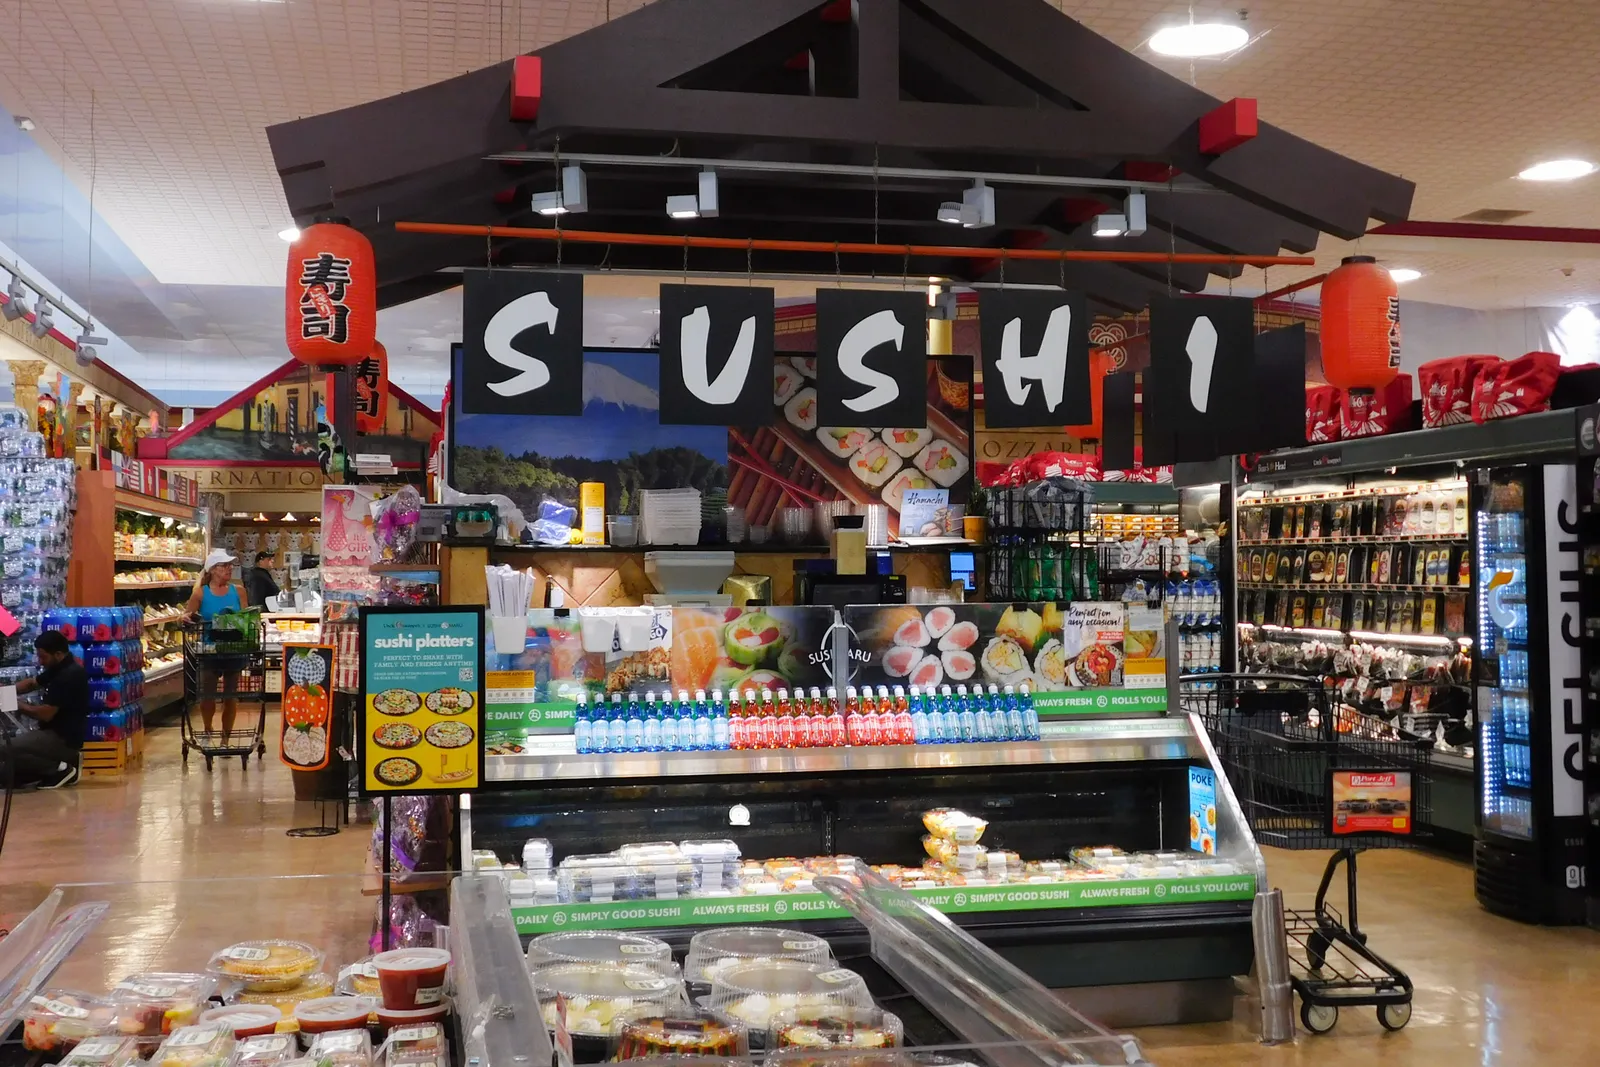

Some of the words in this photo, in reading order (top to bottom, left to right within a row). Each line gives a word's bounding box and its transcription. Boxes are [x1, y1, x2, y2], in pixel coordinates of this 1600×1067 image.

[484, 291, 1218, 414] SUSHI
[908, 492, 944, 505] Hamachi
[348, 542, 369, 553] GIR
[1068, 606, 1097, 619] Perfect
[1097, 607, 1111, 618] for
[1067, 620, 1084, 629] any
[1085, 617, 1121, 626] occasion!
[374, 633, 413, 648] sushi
[415, 633, 474, 652] platters
[1065, 697, 1093, 706] FRESH
[1112, 696, 1139, 705] ROLLS
[1140, 695, 1160, 704] YOU
[495, 711, 524, 720] DAILY
[1191, 773, 1212, 787] POKÉ
[1080, 888, 1118, 898] ALWAYS
[1120, 886, 1150, 896] FRESH
[1170, 884, 1200, 894] ROLLS
[1202, 883, 1224, 892] YOU
[1224, 882, 1249, 891] LOVE
[921, 896, 951, 905] DAILY
[970, 893, 1007, 903] SIMPLY
[1007, 891, 1039, 902] GOOD
[1039, 890, 1070, 900] SUSHI
[692, 904, 735, 915] ALWAYS
[736, 903, 769, 913] FRESH
[792, 900, 824, 911] ROLLS
[826, 900, 841, 909] YO
[516, 914, 548, 925] DAILY
[571, 911, 610, 922] SIMPLY
[611, 909, 646, 920] GOOD
[648, 907, 681, 917] SUSHI
